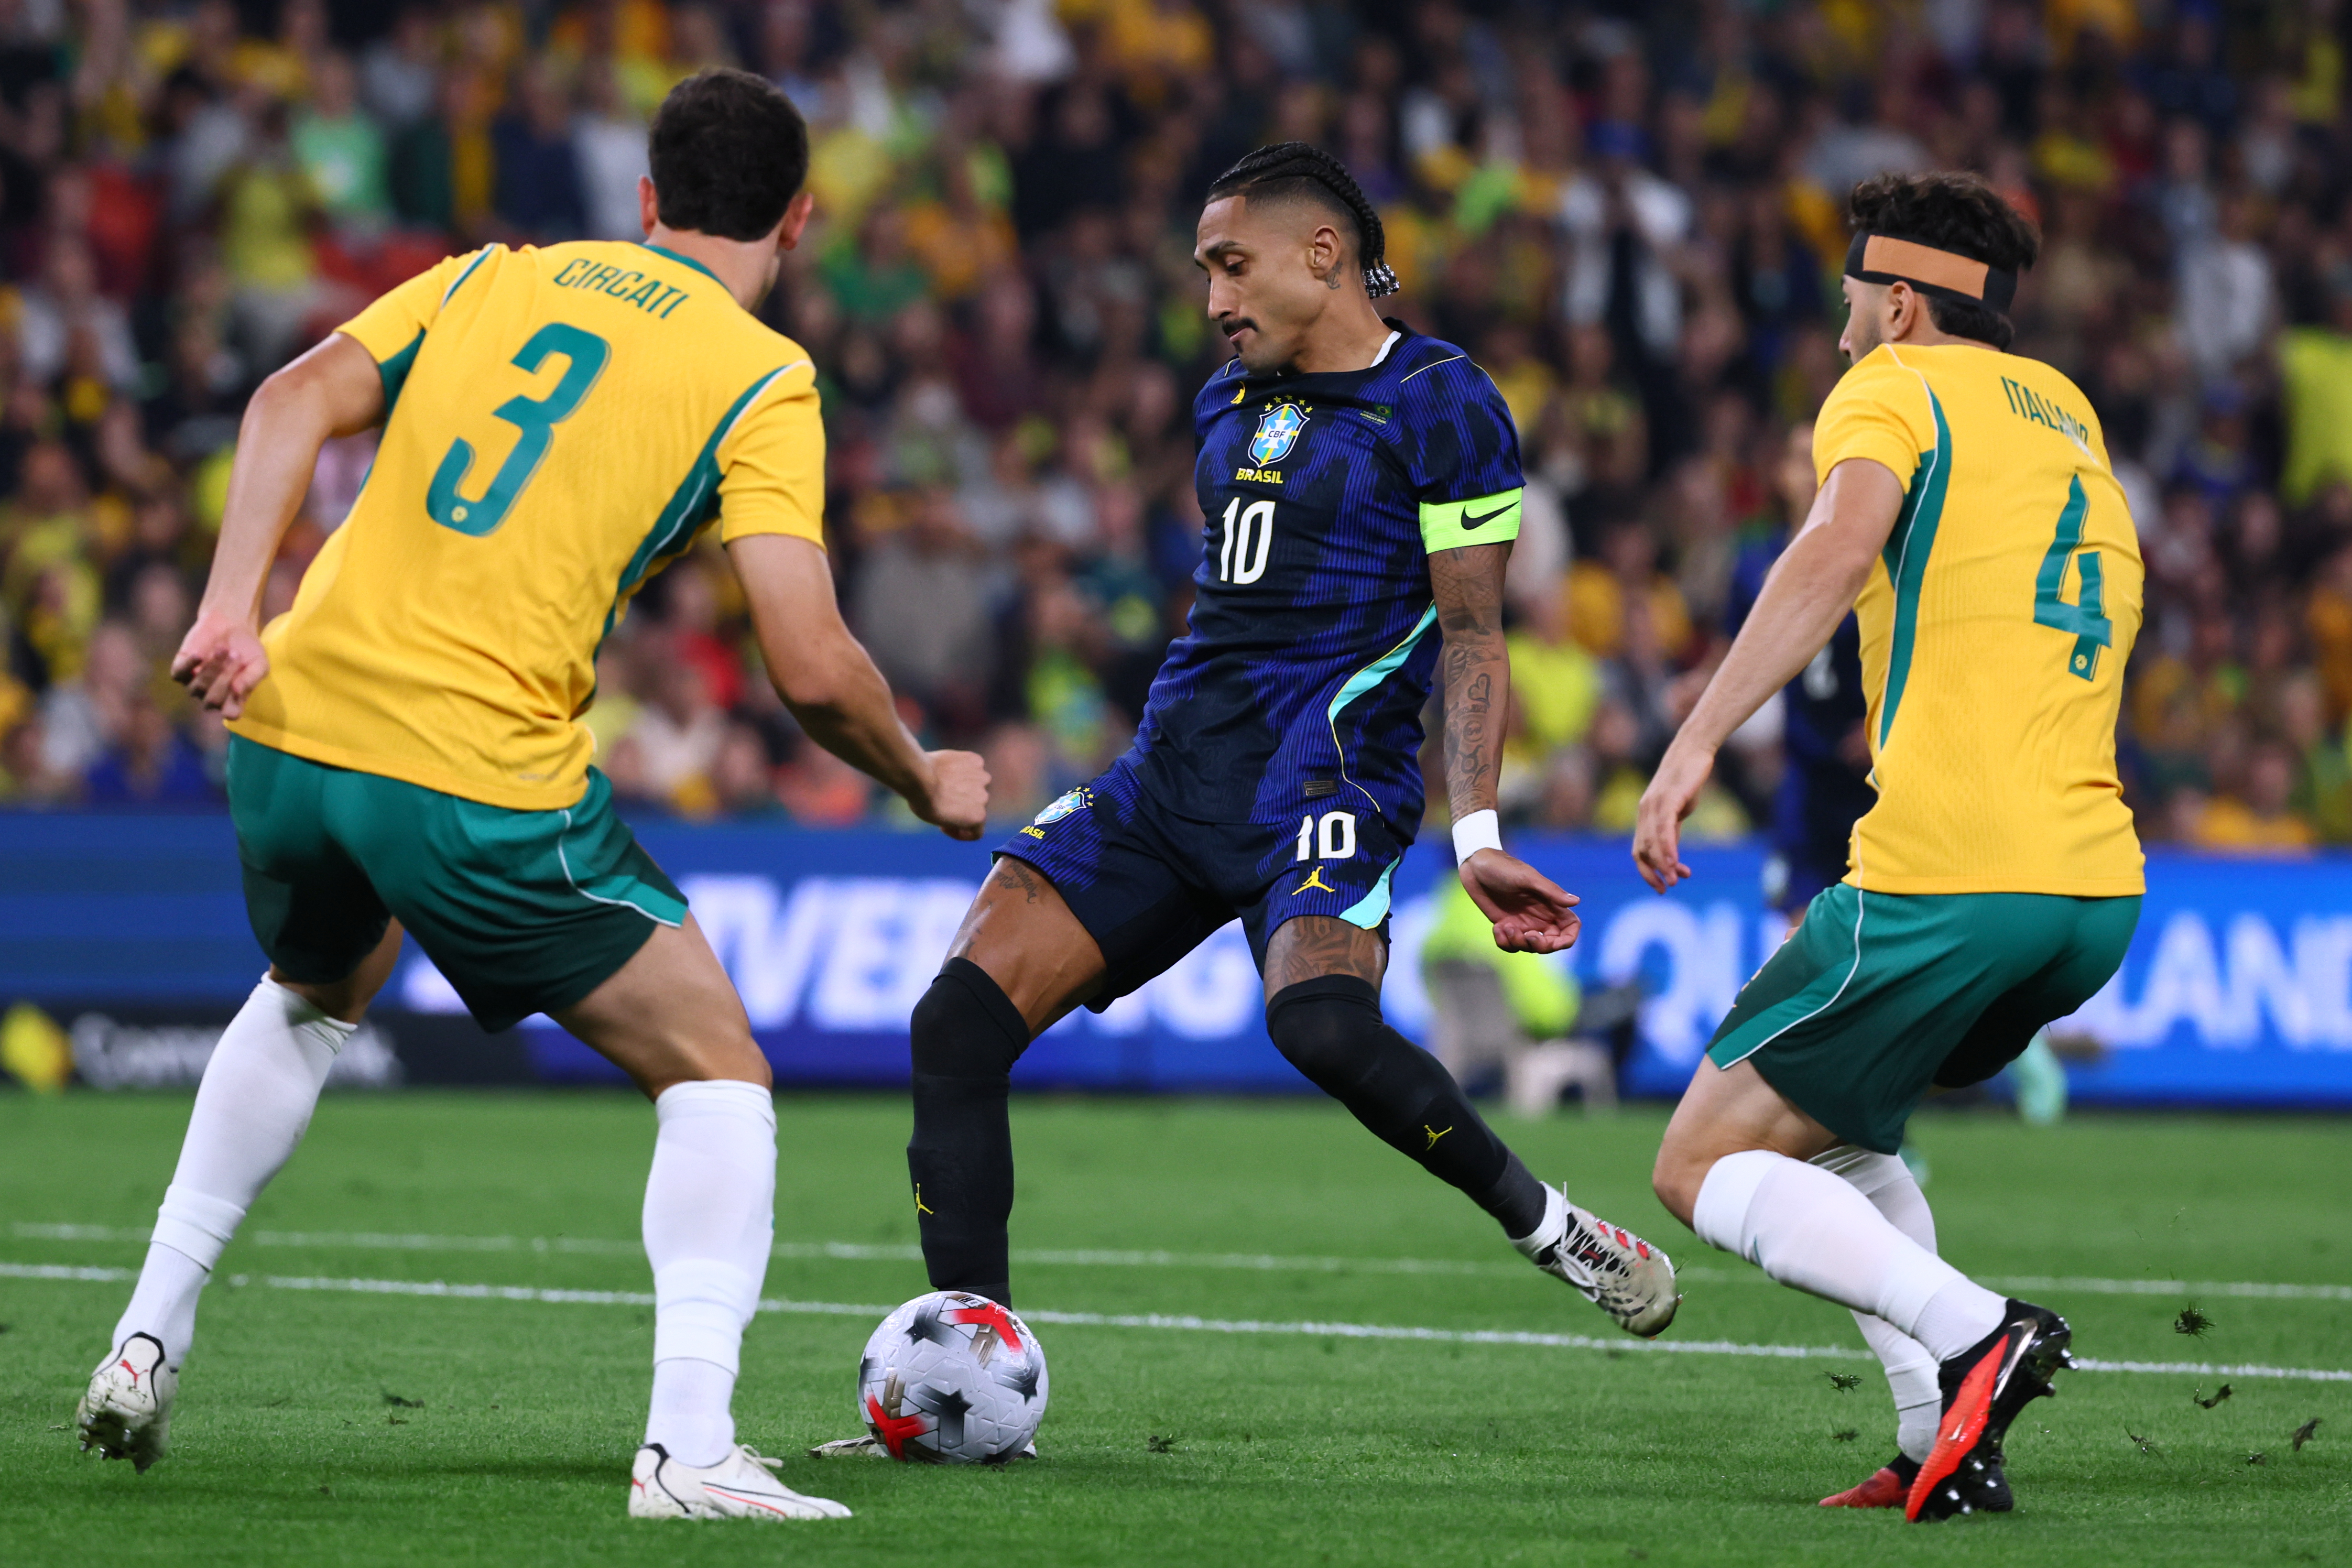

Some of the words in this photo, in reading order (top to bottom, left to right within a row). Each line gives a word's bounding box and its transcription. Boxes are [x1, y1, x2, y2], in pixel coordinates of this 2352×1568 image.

[553, 258, 690, 319] CIRCATI
[426, 322, 612, 537] 3
[1235, 467, 1283, 484] BRASIL
[1220, 497, 1276, 584] 10
[2033, 473, 2112, 682] 4
[1295, 811, 1356, 862] 10
